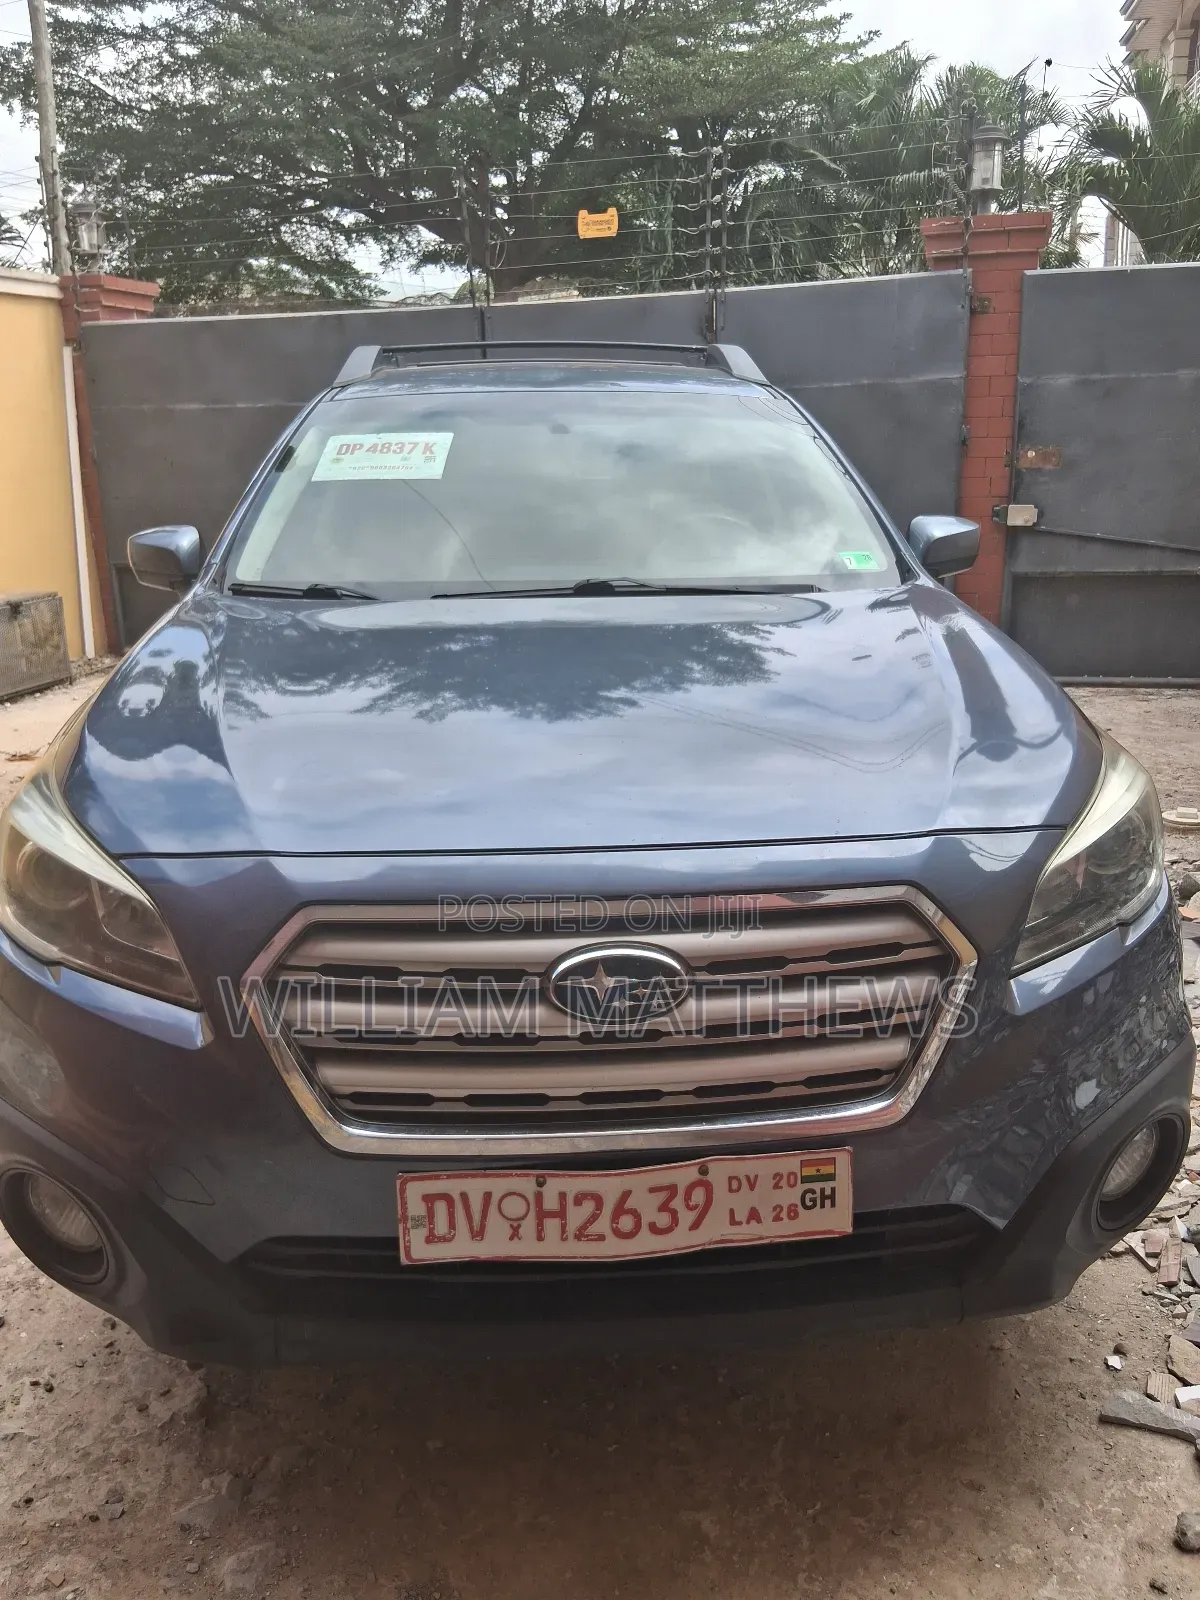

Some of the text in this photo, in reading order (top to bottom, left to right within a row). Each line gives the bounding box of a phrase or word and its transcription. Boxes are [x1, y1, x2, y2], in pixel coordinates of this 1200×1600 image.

[336, 442, 437, 456] DP 4837 K
[727, 1171, 798, 1194] DV 20
[800, 1186, 837, 1211] GH
[728, 1203, 800, 1227] LA 26
